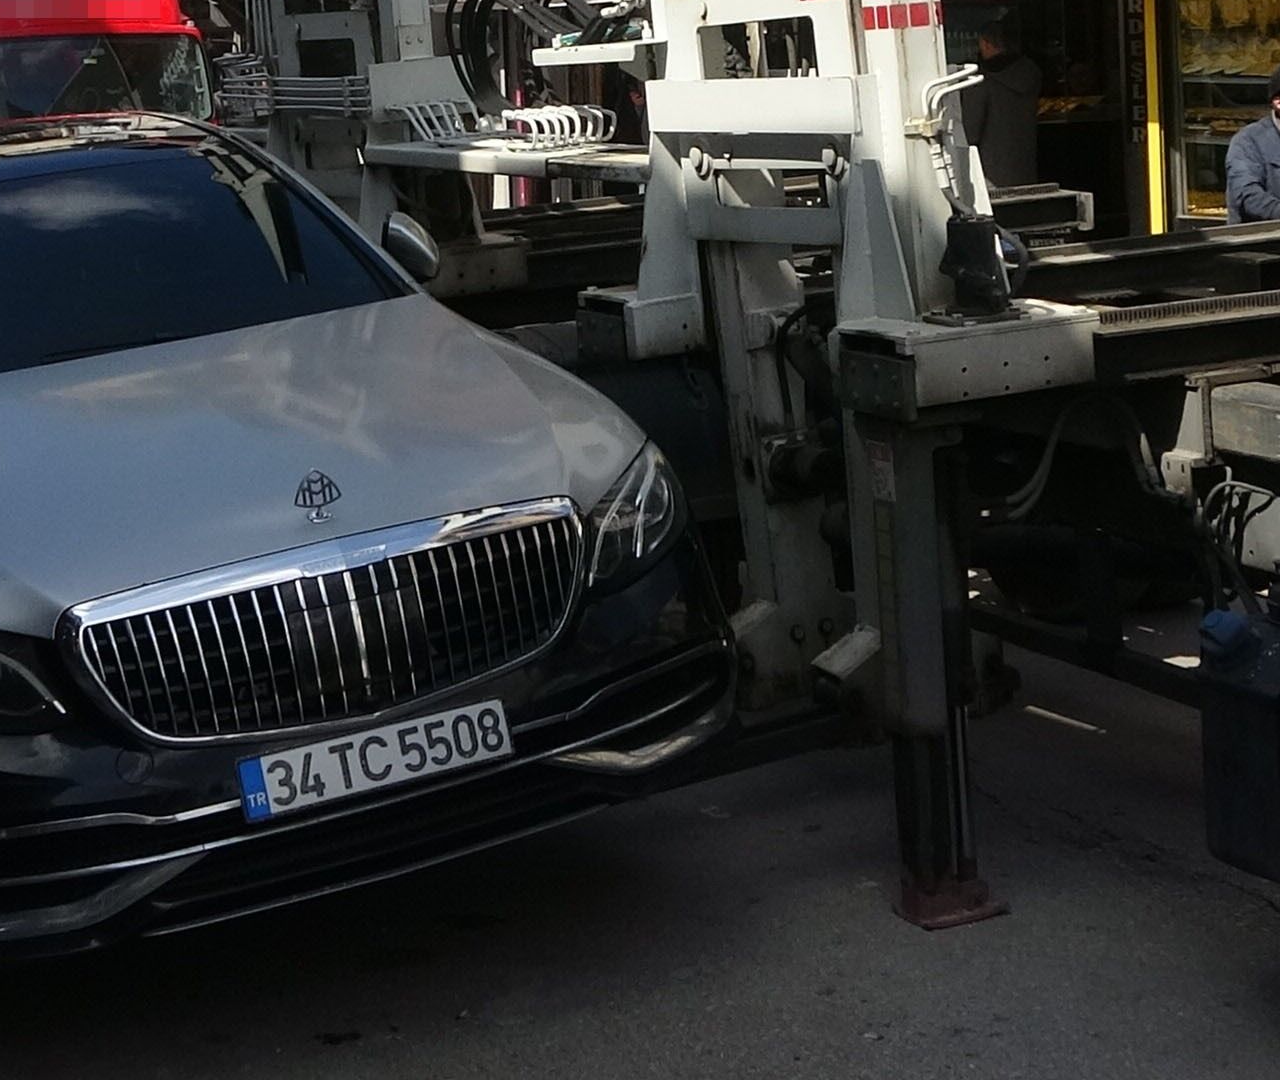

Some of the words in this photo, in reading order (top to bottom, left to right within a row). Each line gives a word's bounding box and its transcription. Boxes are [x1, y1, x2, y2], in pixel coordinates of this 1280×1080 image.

[247, 794, 267, 808] TR
[267, 751, 326, 806] 34
[328, 735, 393, 790] TC
[397, 708, 504, 772] 5508
